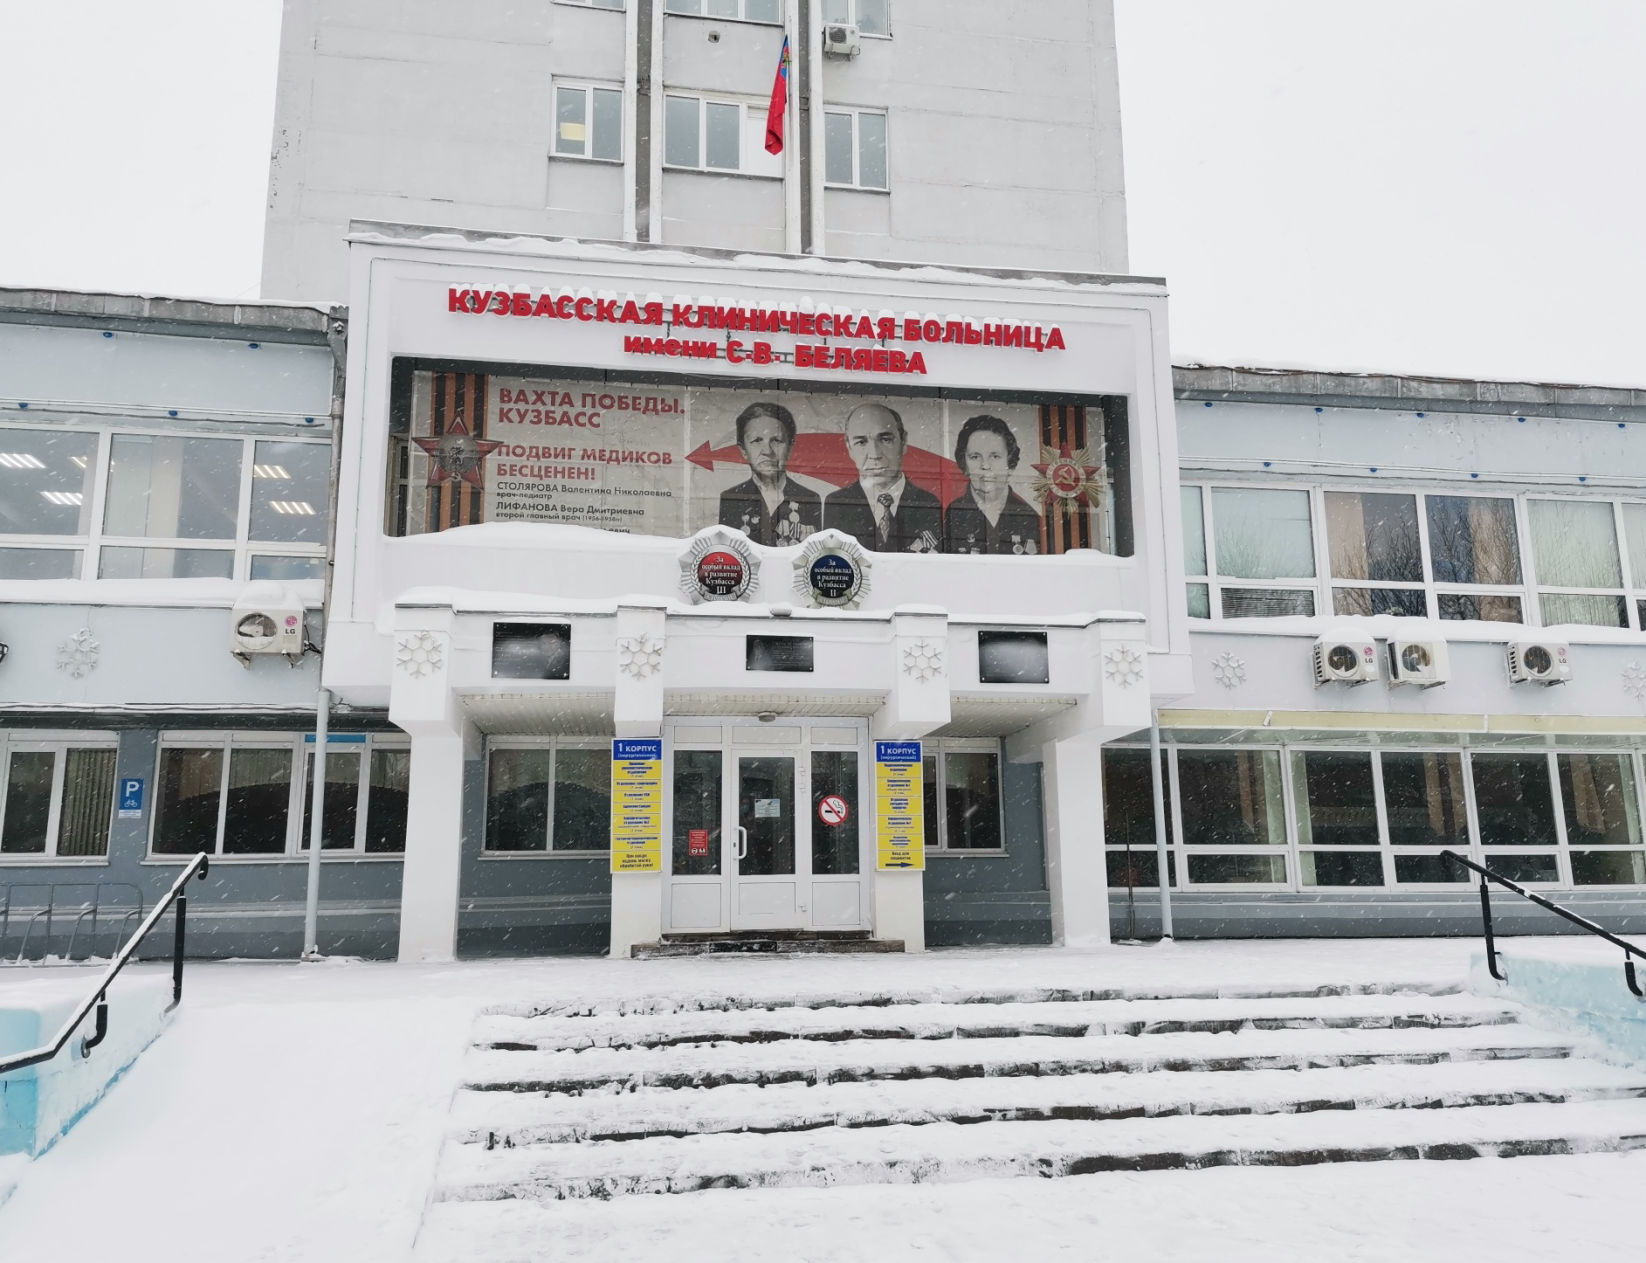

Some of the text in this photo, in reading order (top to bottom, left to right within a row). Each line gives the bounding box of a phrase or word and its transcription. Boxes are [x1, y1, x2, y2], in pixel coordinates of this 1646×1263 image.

[449, 287, 1066, 353] КУЗБАССКАЯ КЛИНИЧЕСКАЯ БОЛЬНИЦА
[624, 335, 717, 359] имени
[795, 344, 928, 375] БЕЛЯЕВА
[499, 388, 686, 415] ВАХТА ПОБЕДЫ.
[498, 407, 601, 428] КУЗБАСС
[497, 444, 673, 465] ПОДВИГ МЕДИКОВ
[496, 463, 596, 481] БЕСЦЕНЕН!
[496, 481, 672, 497] СТОЛЯРОВА Валентина Николаевна
[496, 491, 553, 501] врач-педиатр
[495, 501, 645, 517] ЛИФАНОВА Вера Дмитриевна
[496, 511, 525, 520] второй
[526, 512, 560, 521] главный
[561, 513, 581, 522] врач
[716, 555, 725, 563] За
[827, 558, 837, 566] За
[702, 563, 722, 571] особый
[709, 571, 738, 579] развитие
[705, 578, 735, 587] Кузбасса
[818, 581, 847, 590] Кузбасса
[618, 742, 657, 753] 1 КОРПУС
[880, 745, 917, 755] 1 КОРПУС
[125, 781, 140, 798] P
